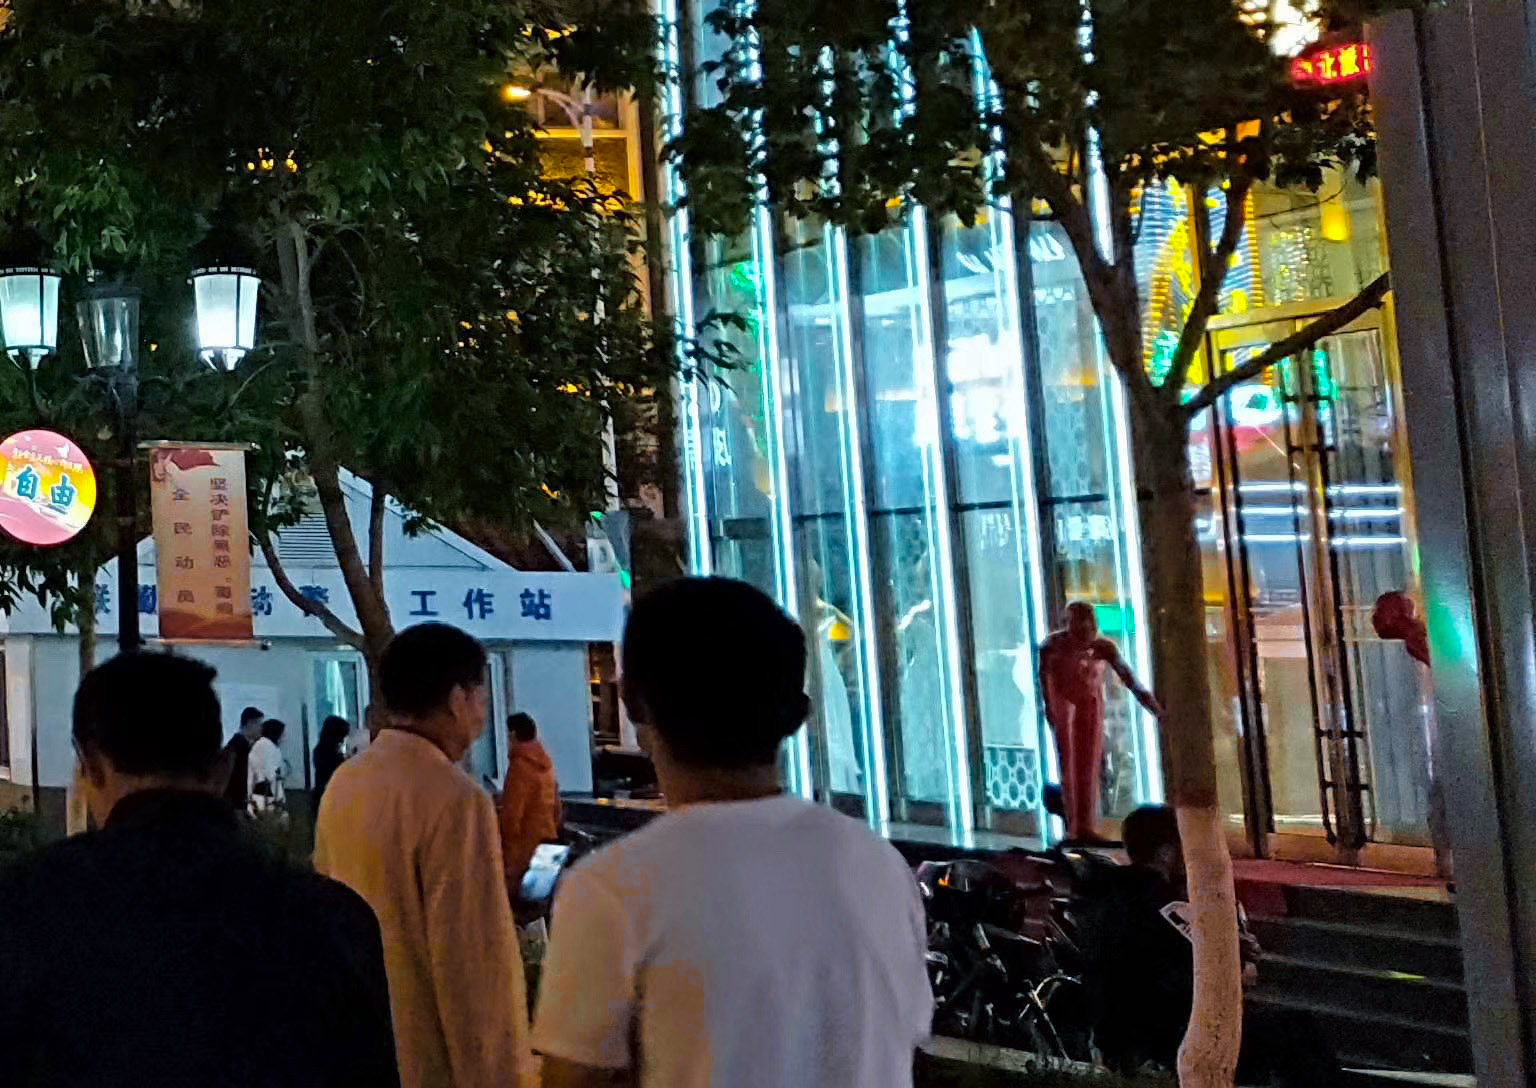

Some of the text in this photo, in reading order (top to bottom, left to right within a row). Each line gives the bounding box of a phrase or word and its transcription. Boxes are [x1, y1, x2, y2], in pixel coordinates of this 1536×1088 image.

[16, 467, 76, 513] 自由
[172, 488, 196, 604] 全民动员
